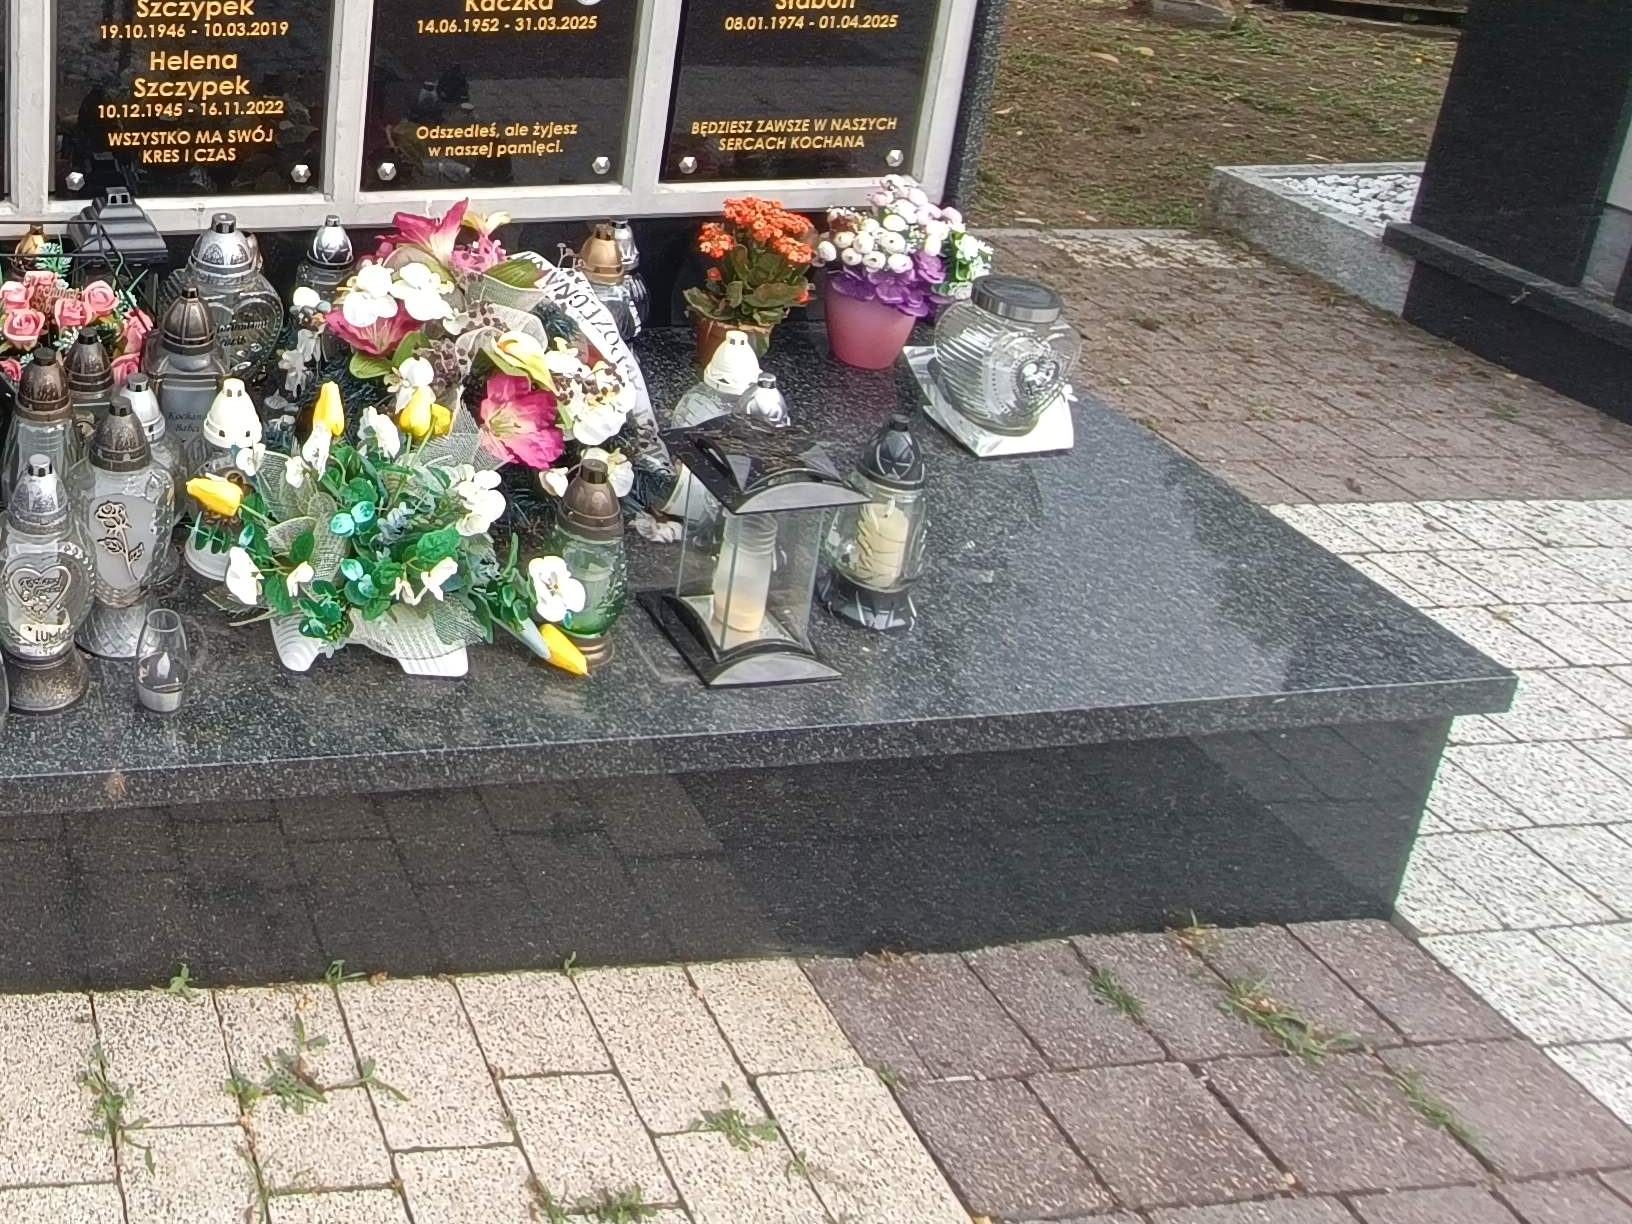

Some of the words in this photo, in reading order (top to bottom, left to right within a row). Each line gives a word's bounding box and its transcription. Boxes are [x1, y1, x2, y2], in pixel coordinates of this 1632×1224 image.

[100, 23, 186, 39] 19.10.1946
[204, 21, 289, 37] 10.03.2019
[417, 17, 500, 34] 14.06.1952
[514, 15, 598, 32] 31.03.2025
[724, 15, 805, 31] 08.01.1974
[818, 14, 899, 29] 01.04.2025
[148, 48, 239, 72] Helena
[132, 74, 251, 102] Szczypek
[97, 102, 183, 119] 10.12.1945
[200, 100, 284, 116] 16.11.2022
[107, 130, 191, 147] WSZYSTKO
[195, 129, 224, 144] MA
[227, 124, 274, 144] SWÓJ
[504, 122, 529, 137] ale
[532, 121, 578, 139] żyjesz
[691, 120, 754, 138] BĘDZIESZ
[755, 118, 811, 133] ZAWSZE
[830, 117, 898, 131] NASZYCH
[444, 141, 494, 159] naszej
[496, 139, 564, 158] pamięci.
[718, 136, 787, 151] SERCACH
[790, 135, 865, 149] KOCHANA
[142, 148, 180, 164] KRES
[193, 147, 236, 162] CZAS
